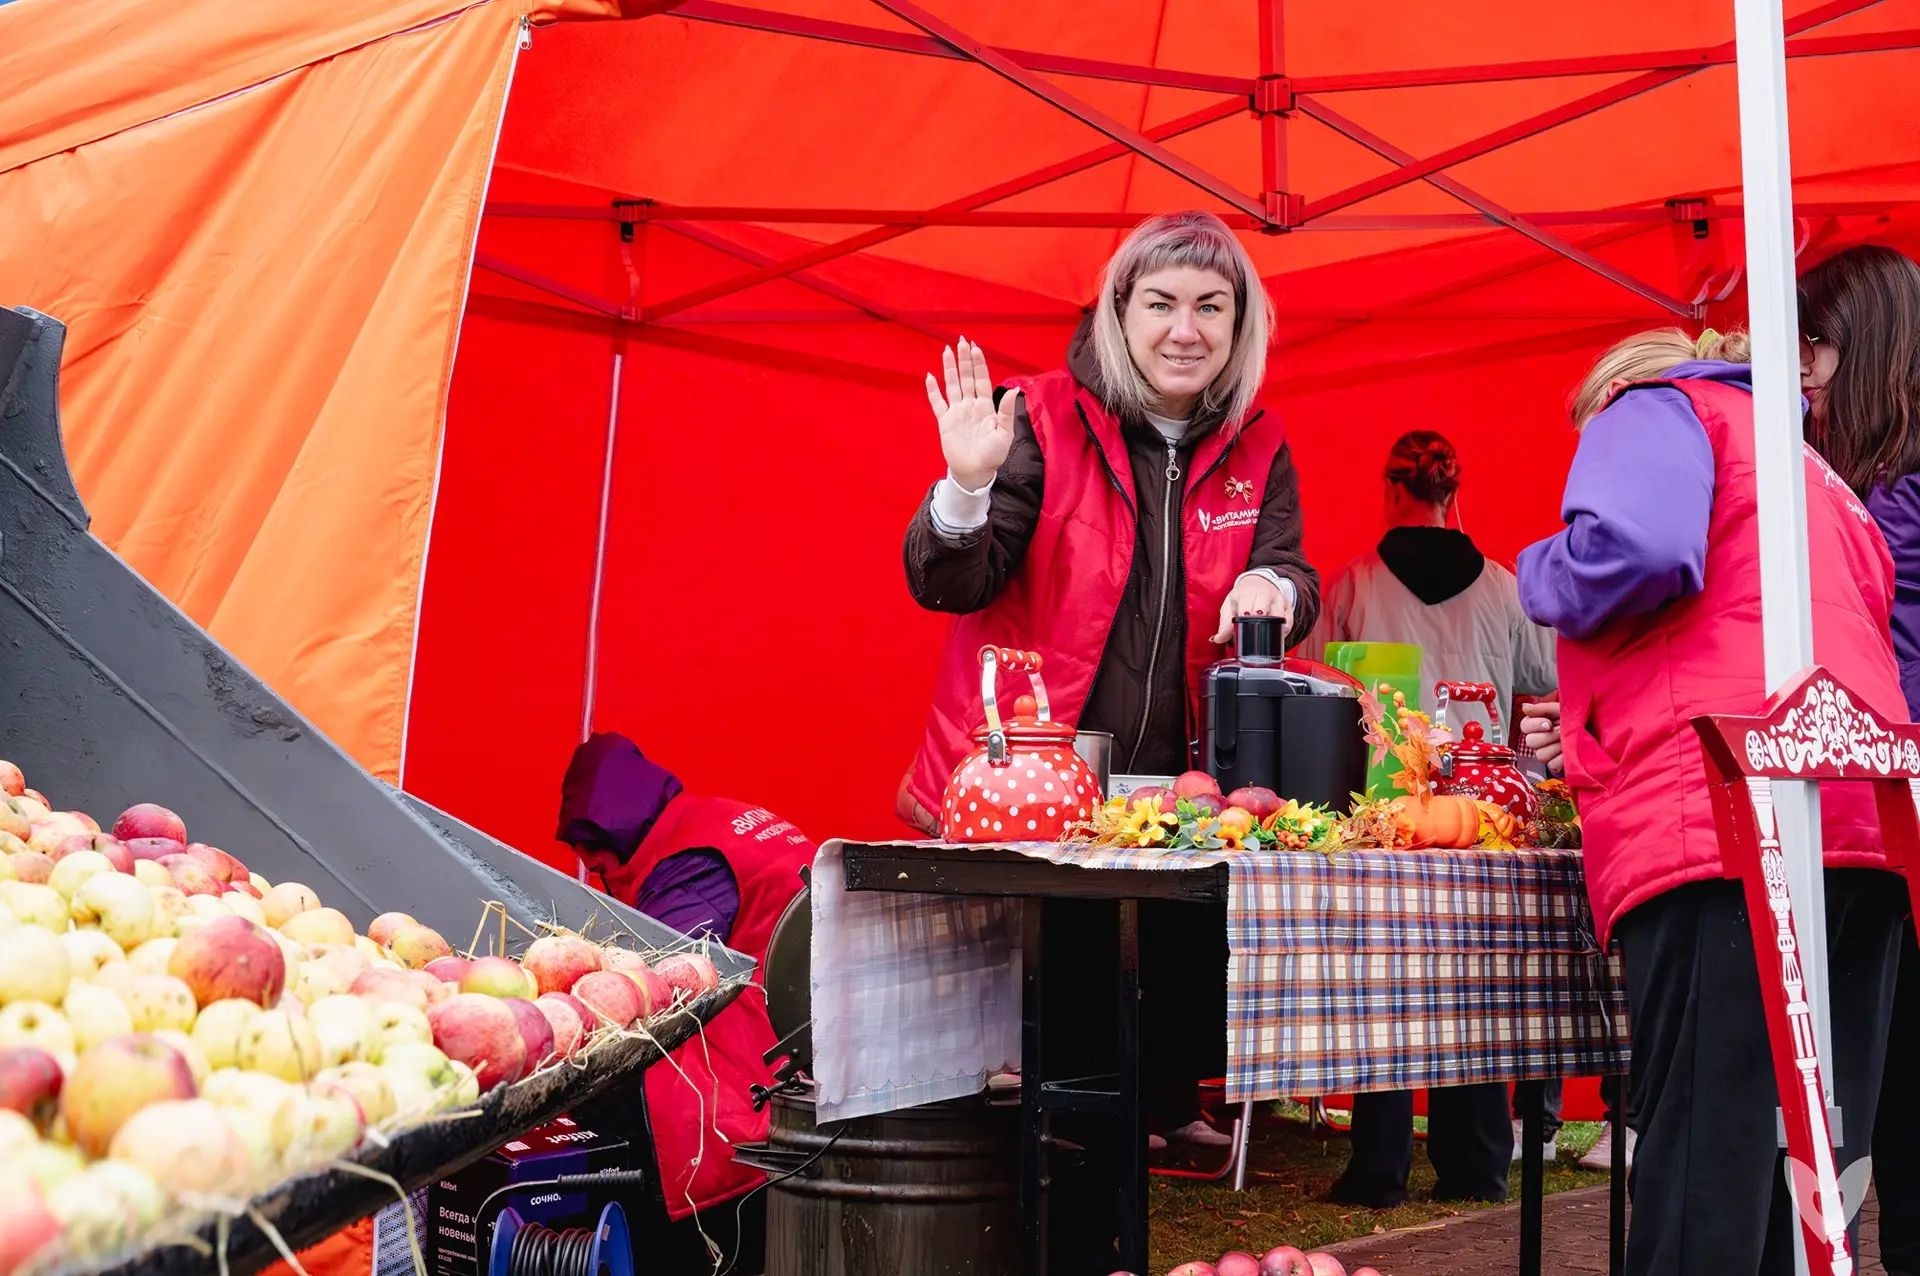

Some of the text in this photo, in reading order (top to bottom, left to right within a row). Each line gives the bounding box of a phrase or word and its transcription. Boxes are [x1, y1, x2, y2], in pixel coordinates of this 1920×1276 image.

[545, 1130, 599, 1144] Kitfort
[440, 1180, 457, 1192] Kitfort
[530, 1193, 561, 1206] сочно.
[439, 1206, 470, 1224] Всегда
